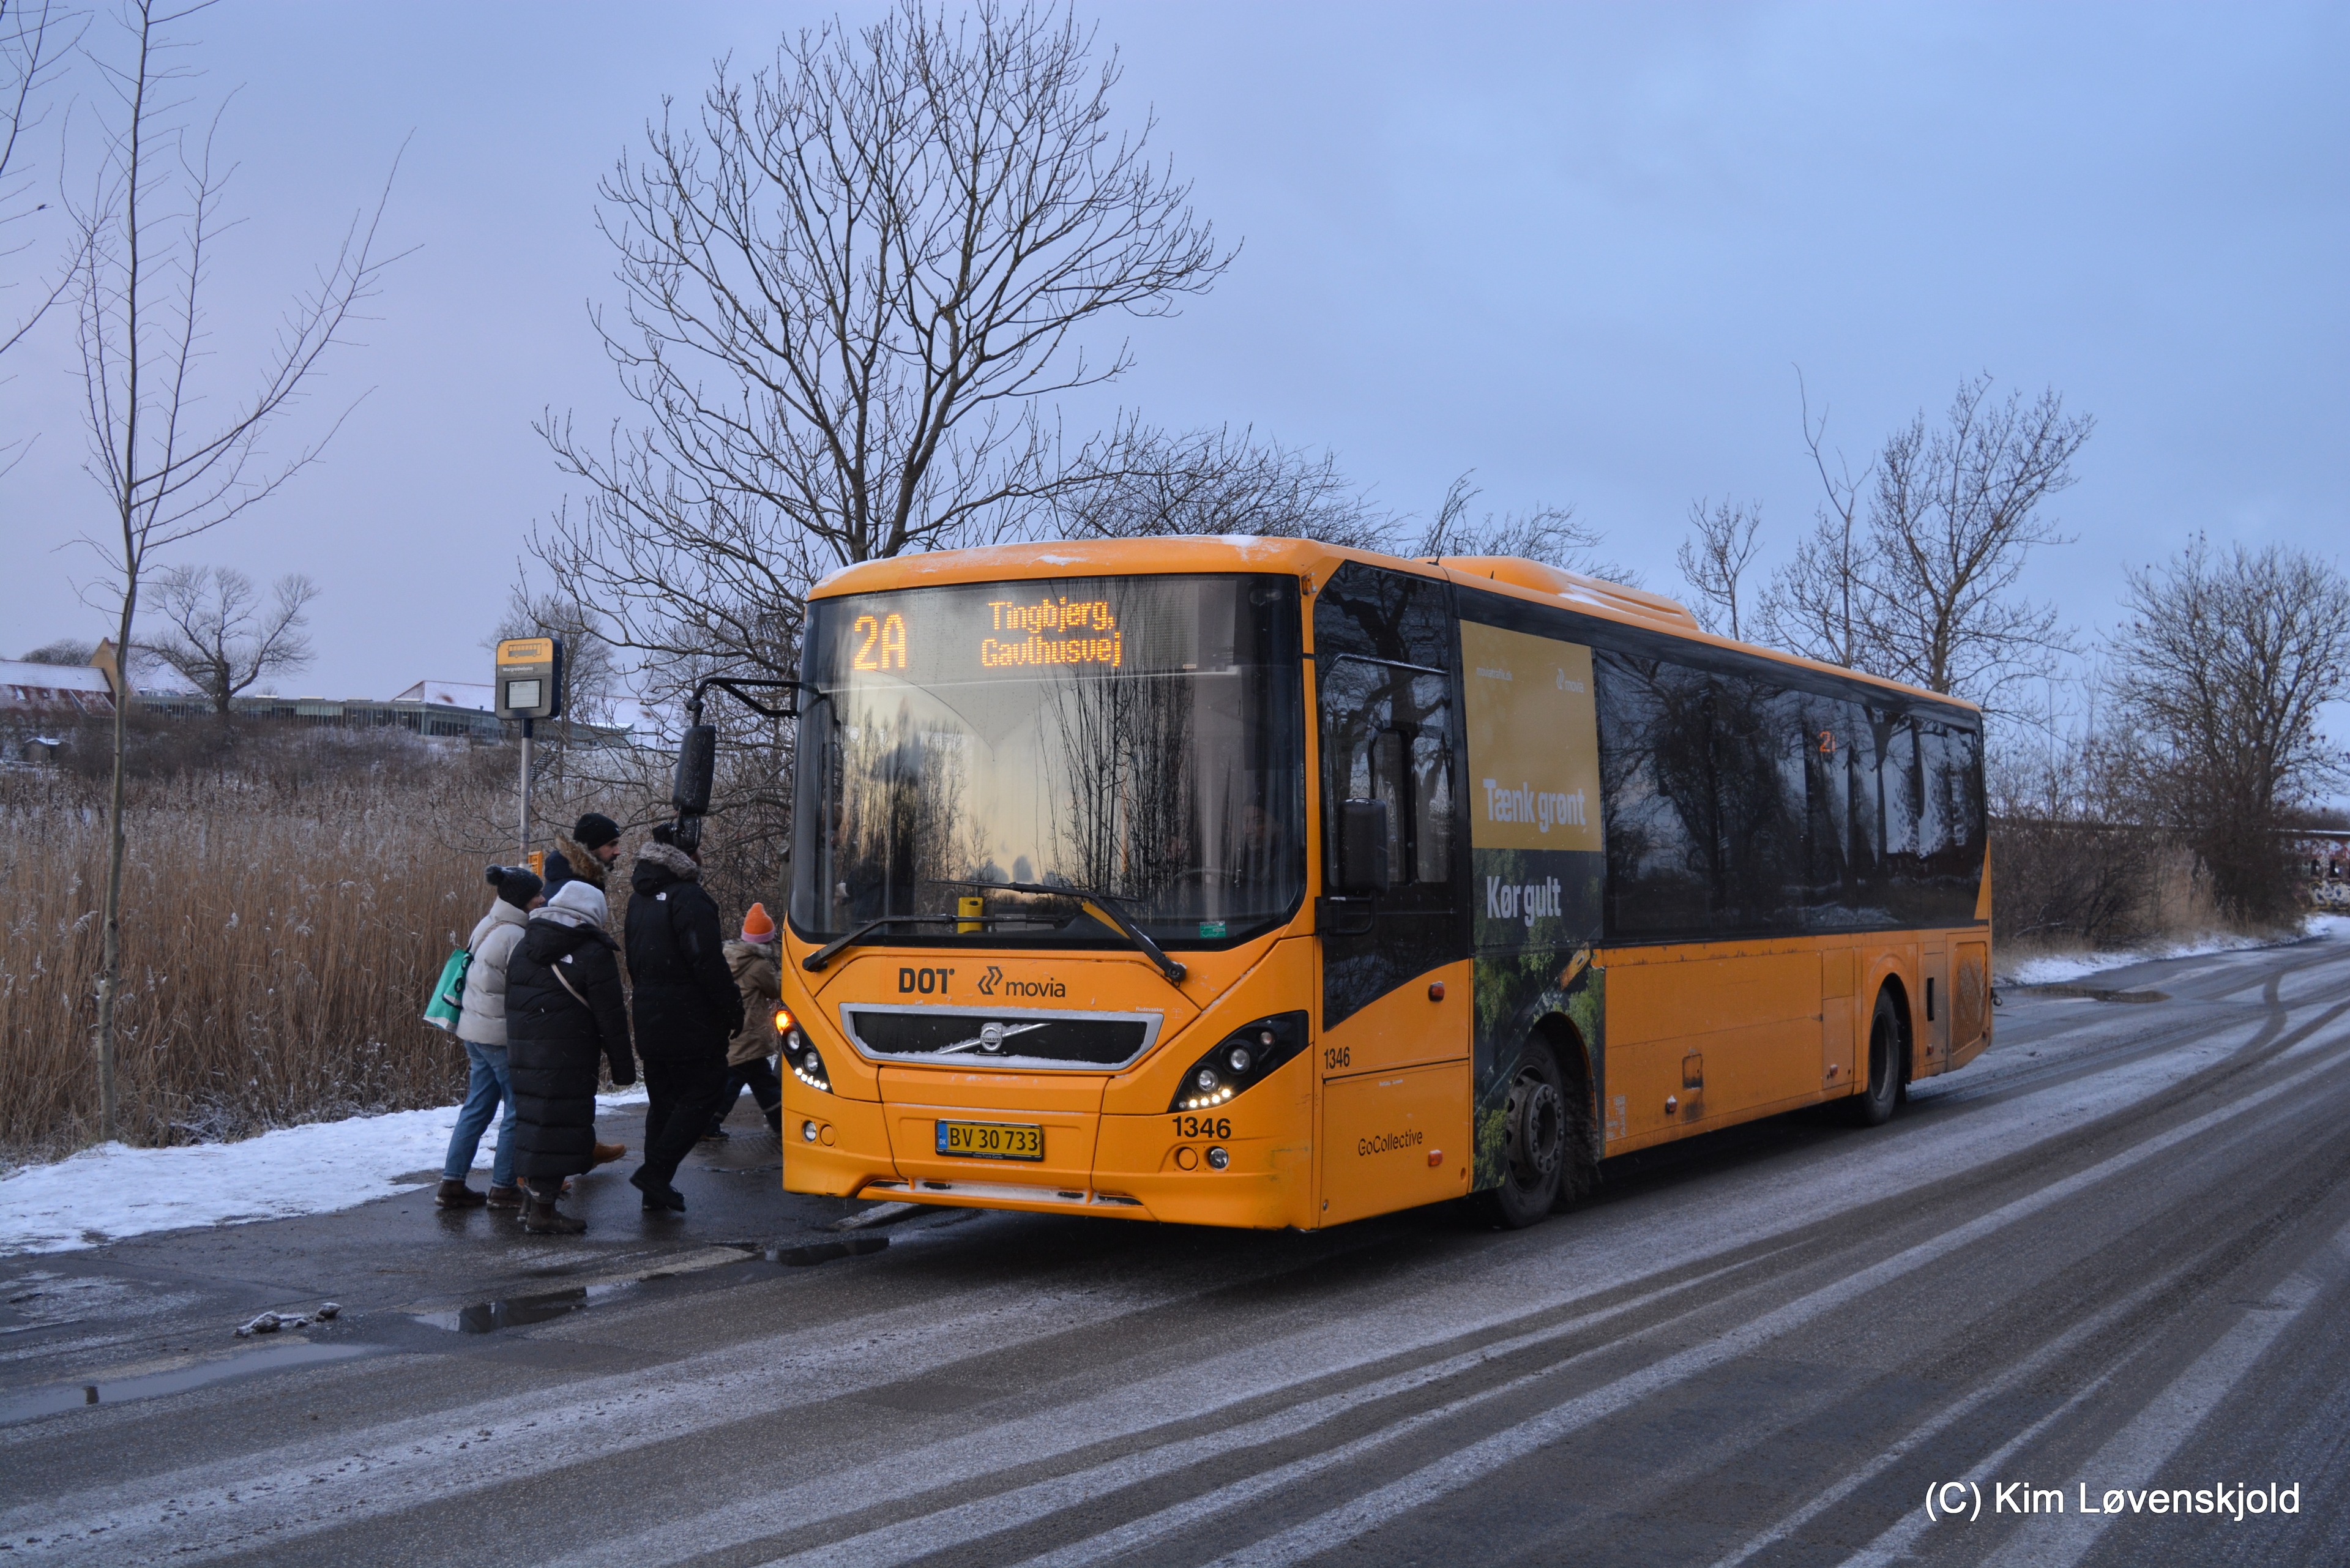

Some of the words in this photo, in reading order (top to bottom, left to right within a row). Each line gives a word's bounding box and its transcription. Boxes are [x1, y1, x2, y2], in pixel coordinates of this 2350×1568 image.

[987, 596, 1115, 633] Tingbjerg,
[854, 614, 906, 670] 2A
[982, 632, 1121, 667] Gavlhusvej
[1565, 679, 1584, 693] movia
[1483, 778, 1535, 823] Tænk
[1538, 788, 1586, 833] grønt
[1486, 876, 1521, 918] Kør
[1524, 876, 1561, 927] gult
[898, 968, 955, 995] DOT
[1005, 977, 1066, 998] movia
[1324, 1046, 1350, 1070] 1346
[950, 1128, 973, 1148] BV
[979, 1129, 999, 1149] 30
[1004, 1130, 1039, 1151] 733
[1172, 1116, 1231, 1139] 1346
[1358, 1129, 1423, 1156] GoCollective
